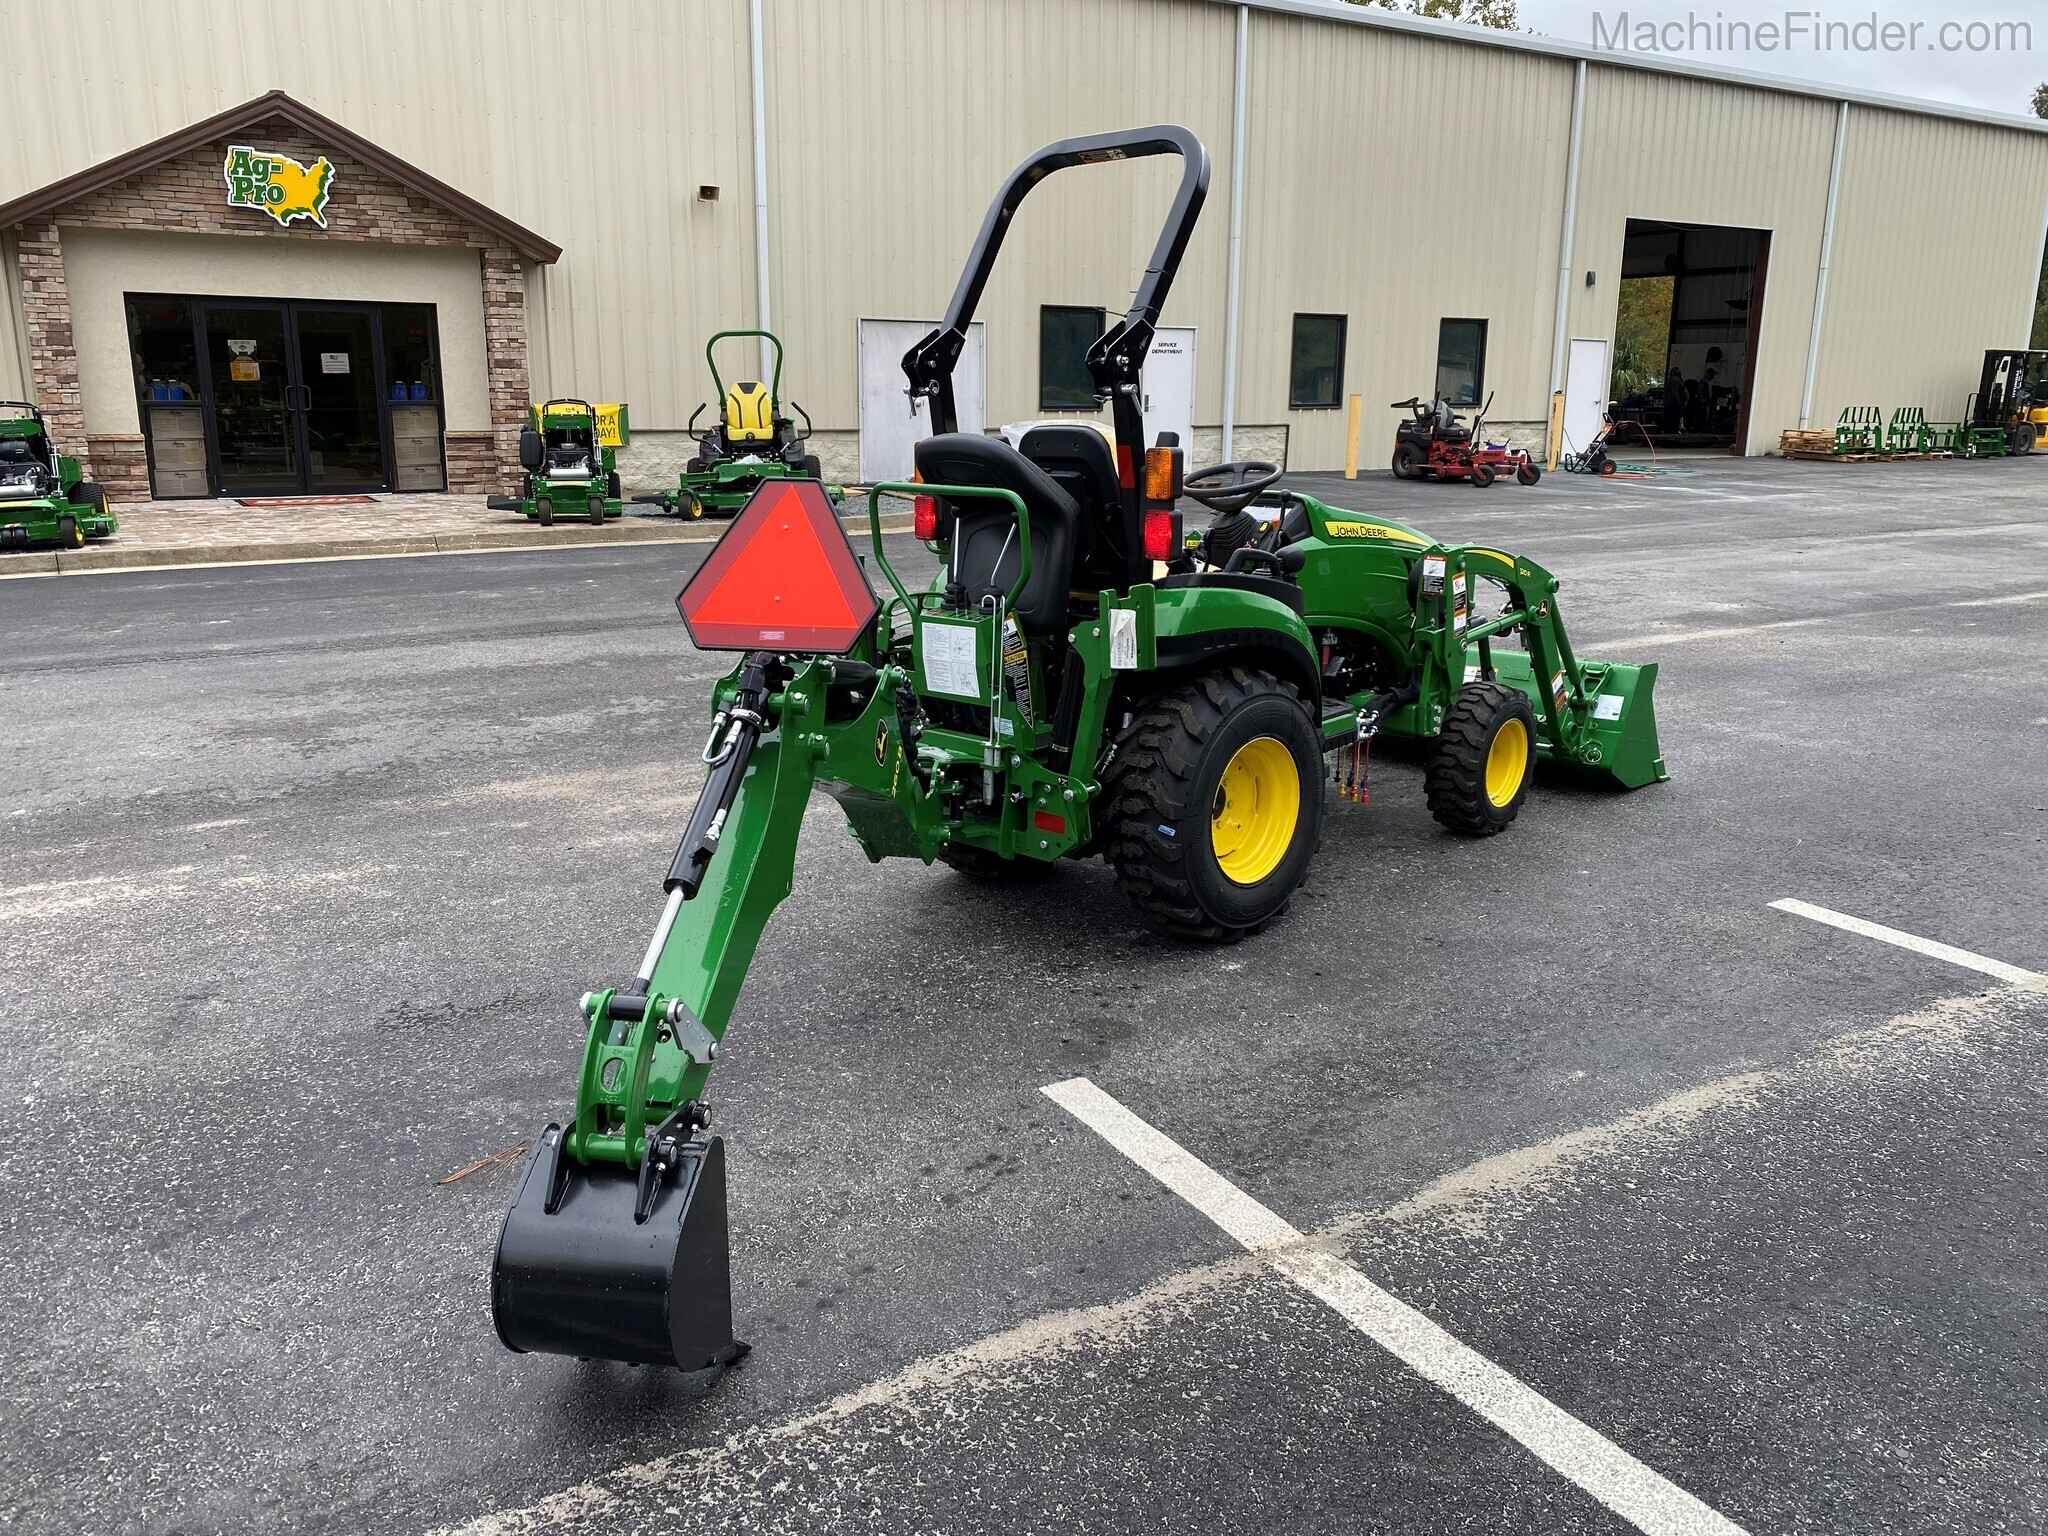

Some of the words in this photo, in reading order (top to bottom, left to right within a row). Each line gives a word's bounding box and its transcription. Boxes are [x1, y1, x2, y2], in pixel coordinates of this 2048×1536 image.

[229, 149, 282, 183] Ag-
[232, 177, 286, 204] Pro
[608, 414, 616, 426] A
[1335, 525, 1359, 536] JOHN
[1360, 525, 1389, 537] DEERE
